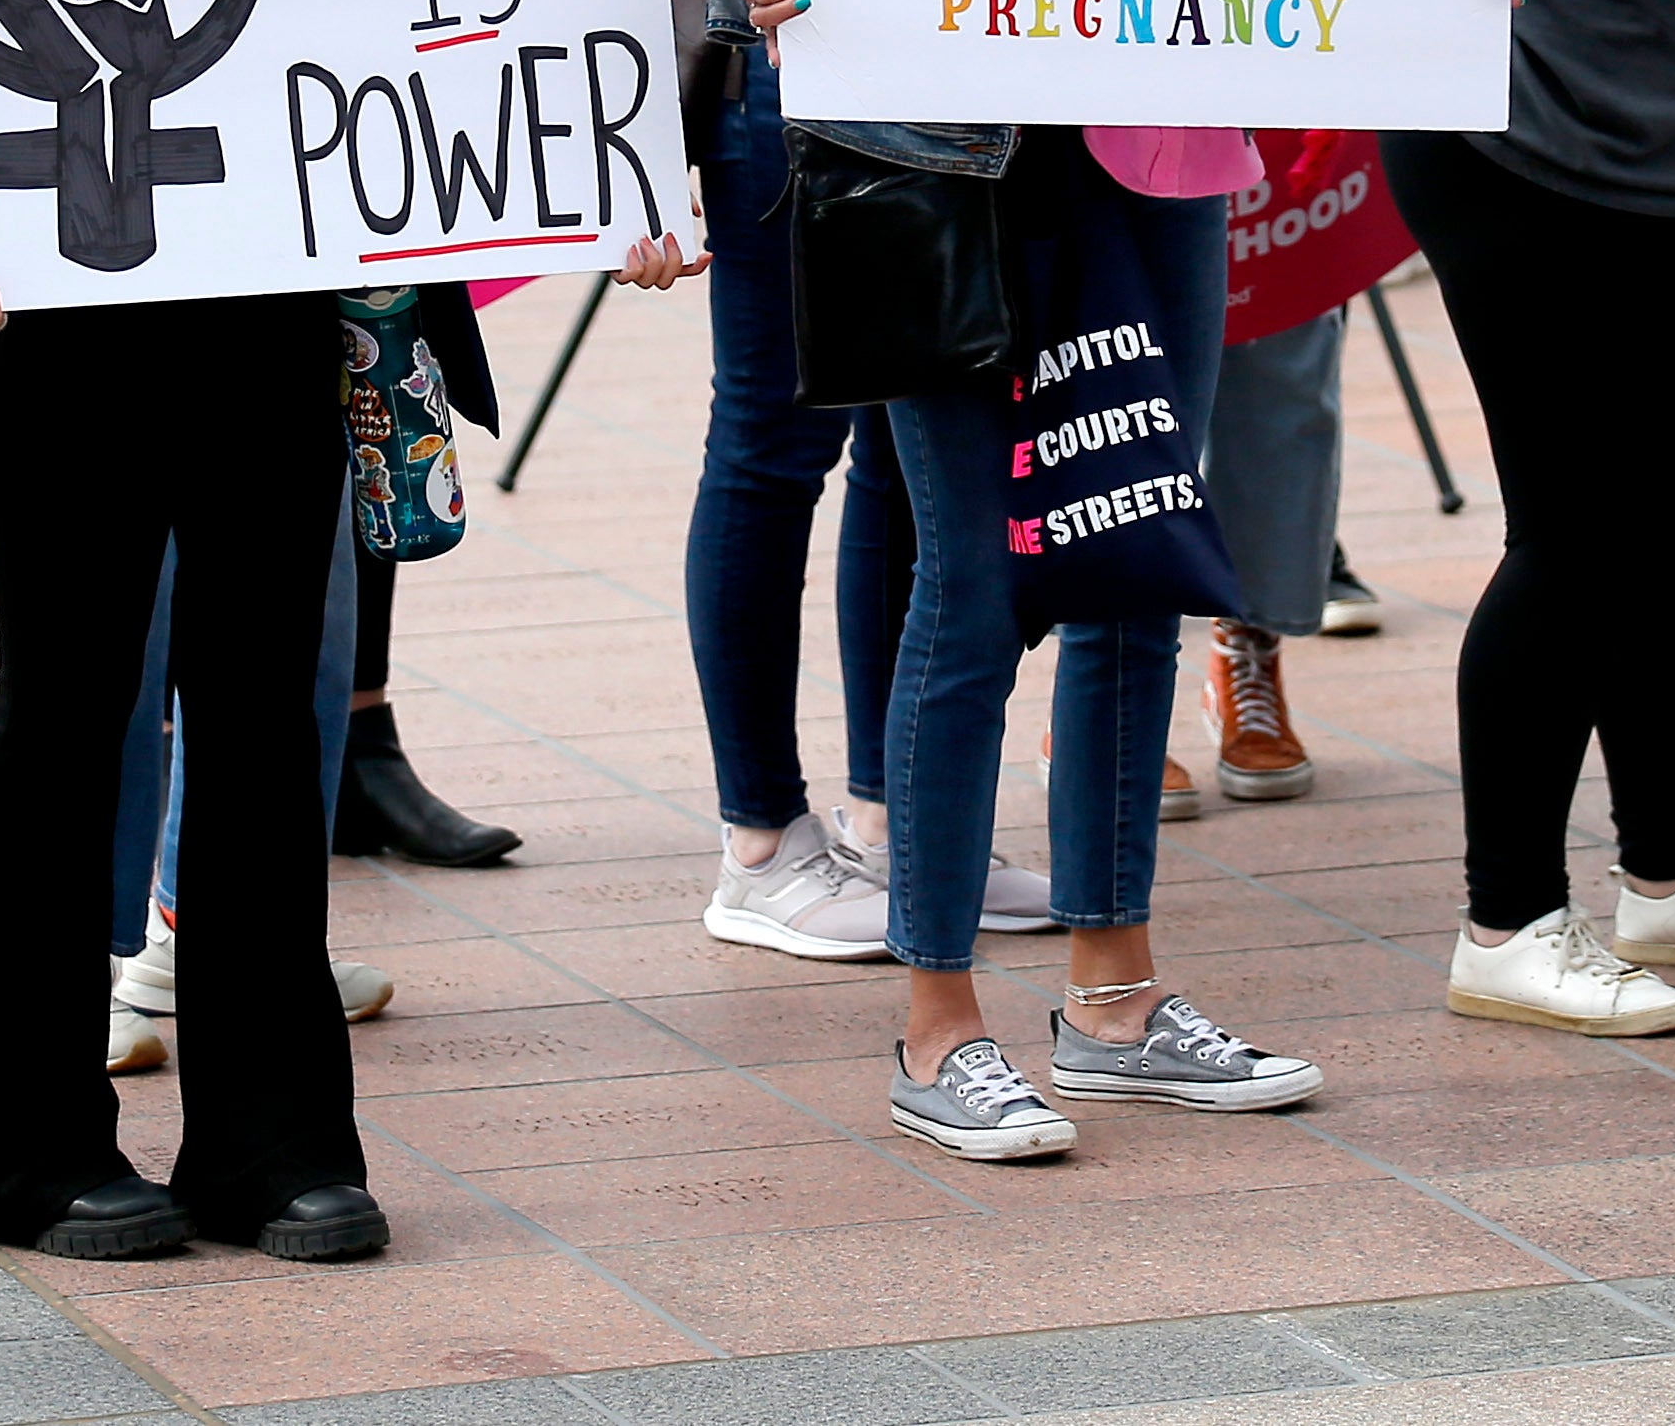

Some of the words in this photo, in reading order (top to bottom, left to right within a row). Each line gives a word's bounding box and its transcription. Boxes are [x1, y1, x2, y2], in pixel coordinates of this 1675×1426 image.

[287, 30, 662, 257] POWER
[1227, 170, 1369, 262] HOOD
[1031, 322, 1164, 395] APITOL.
[1046, 473, 1204, 545] STREETS.
